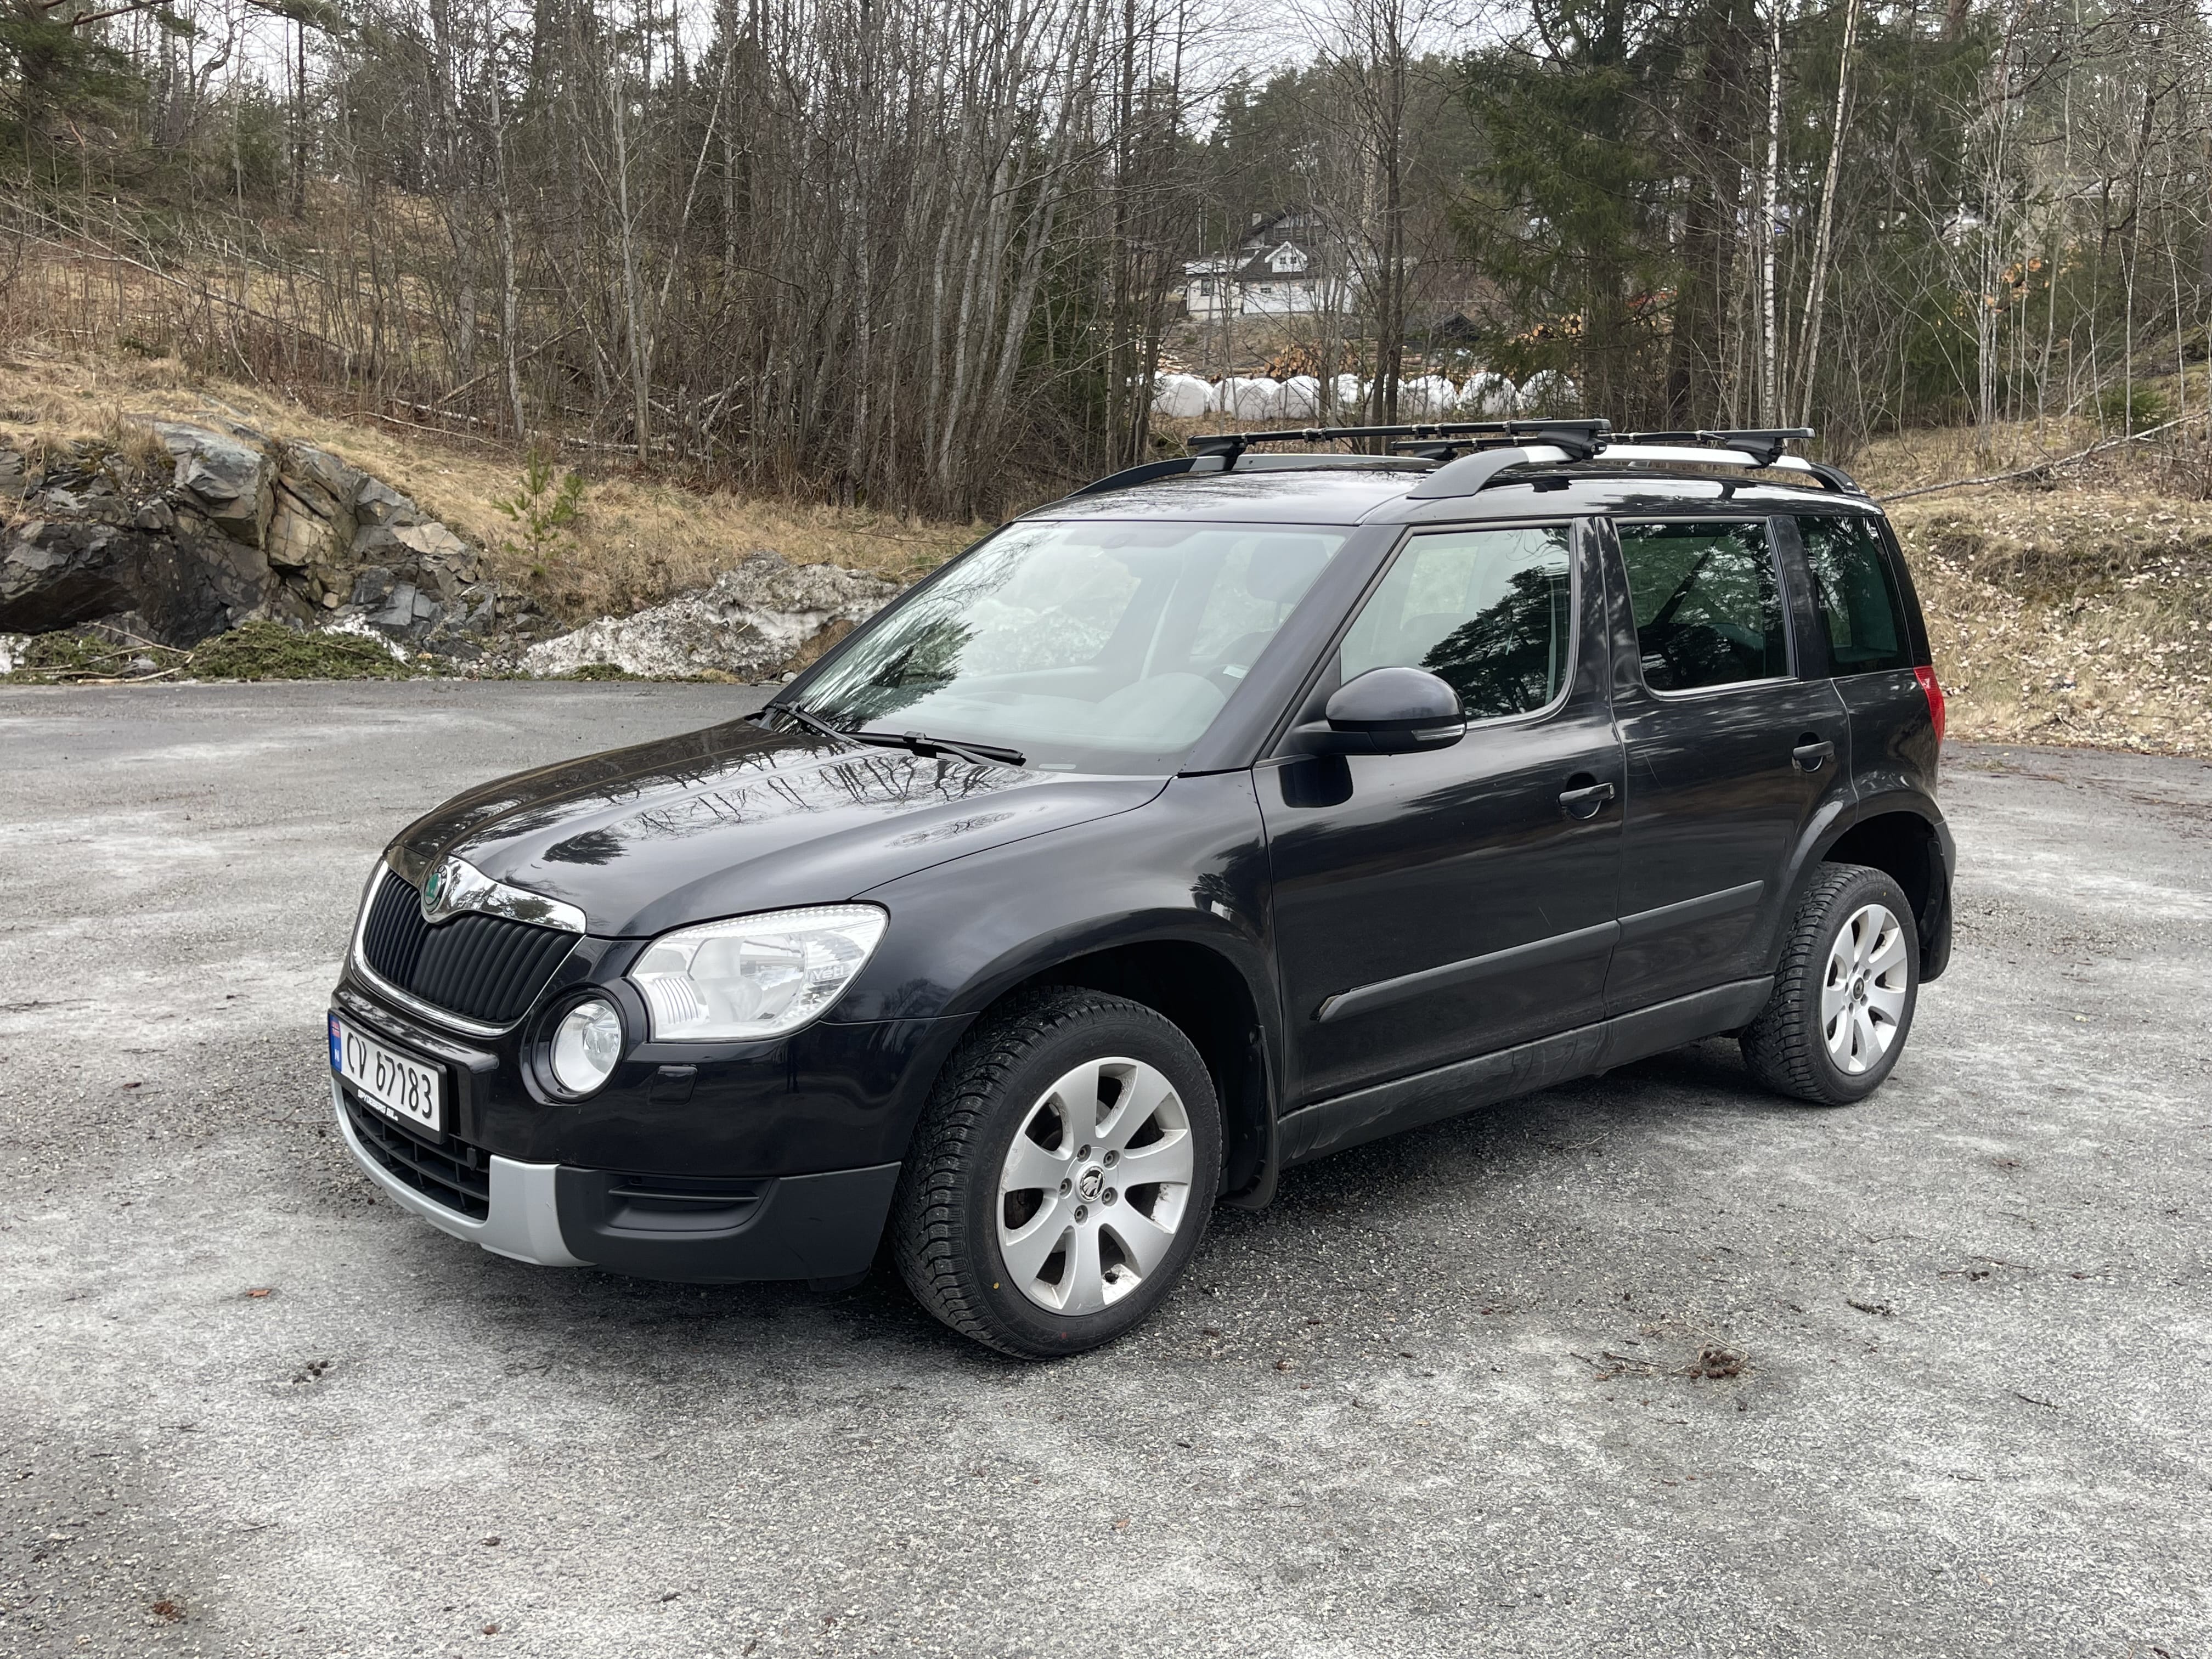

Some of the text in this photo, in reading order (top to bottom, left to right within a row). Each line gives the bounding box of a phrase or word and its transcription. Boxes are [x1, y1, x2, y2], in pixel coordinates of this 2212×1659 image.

[812, 966, 844, 979] Yeti
[335, 1049, 340, 1062] N
[347, 1032, 432, 1119] CV 67183
